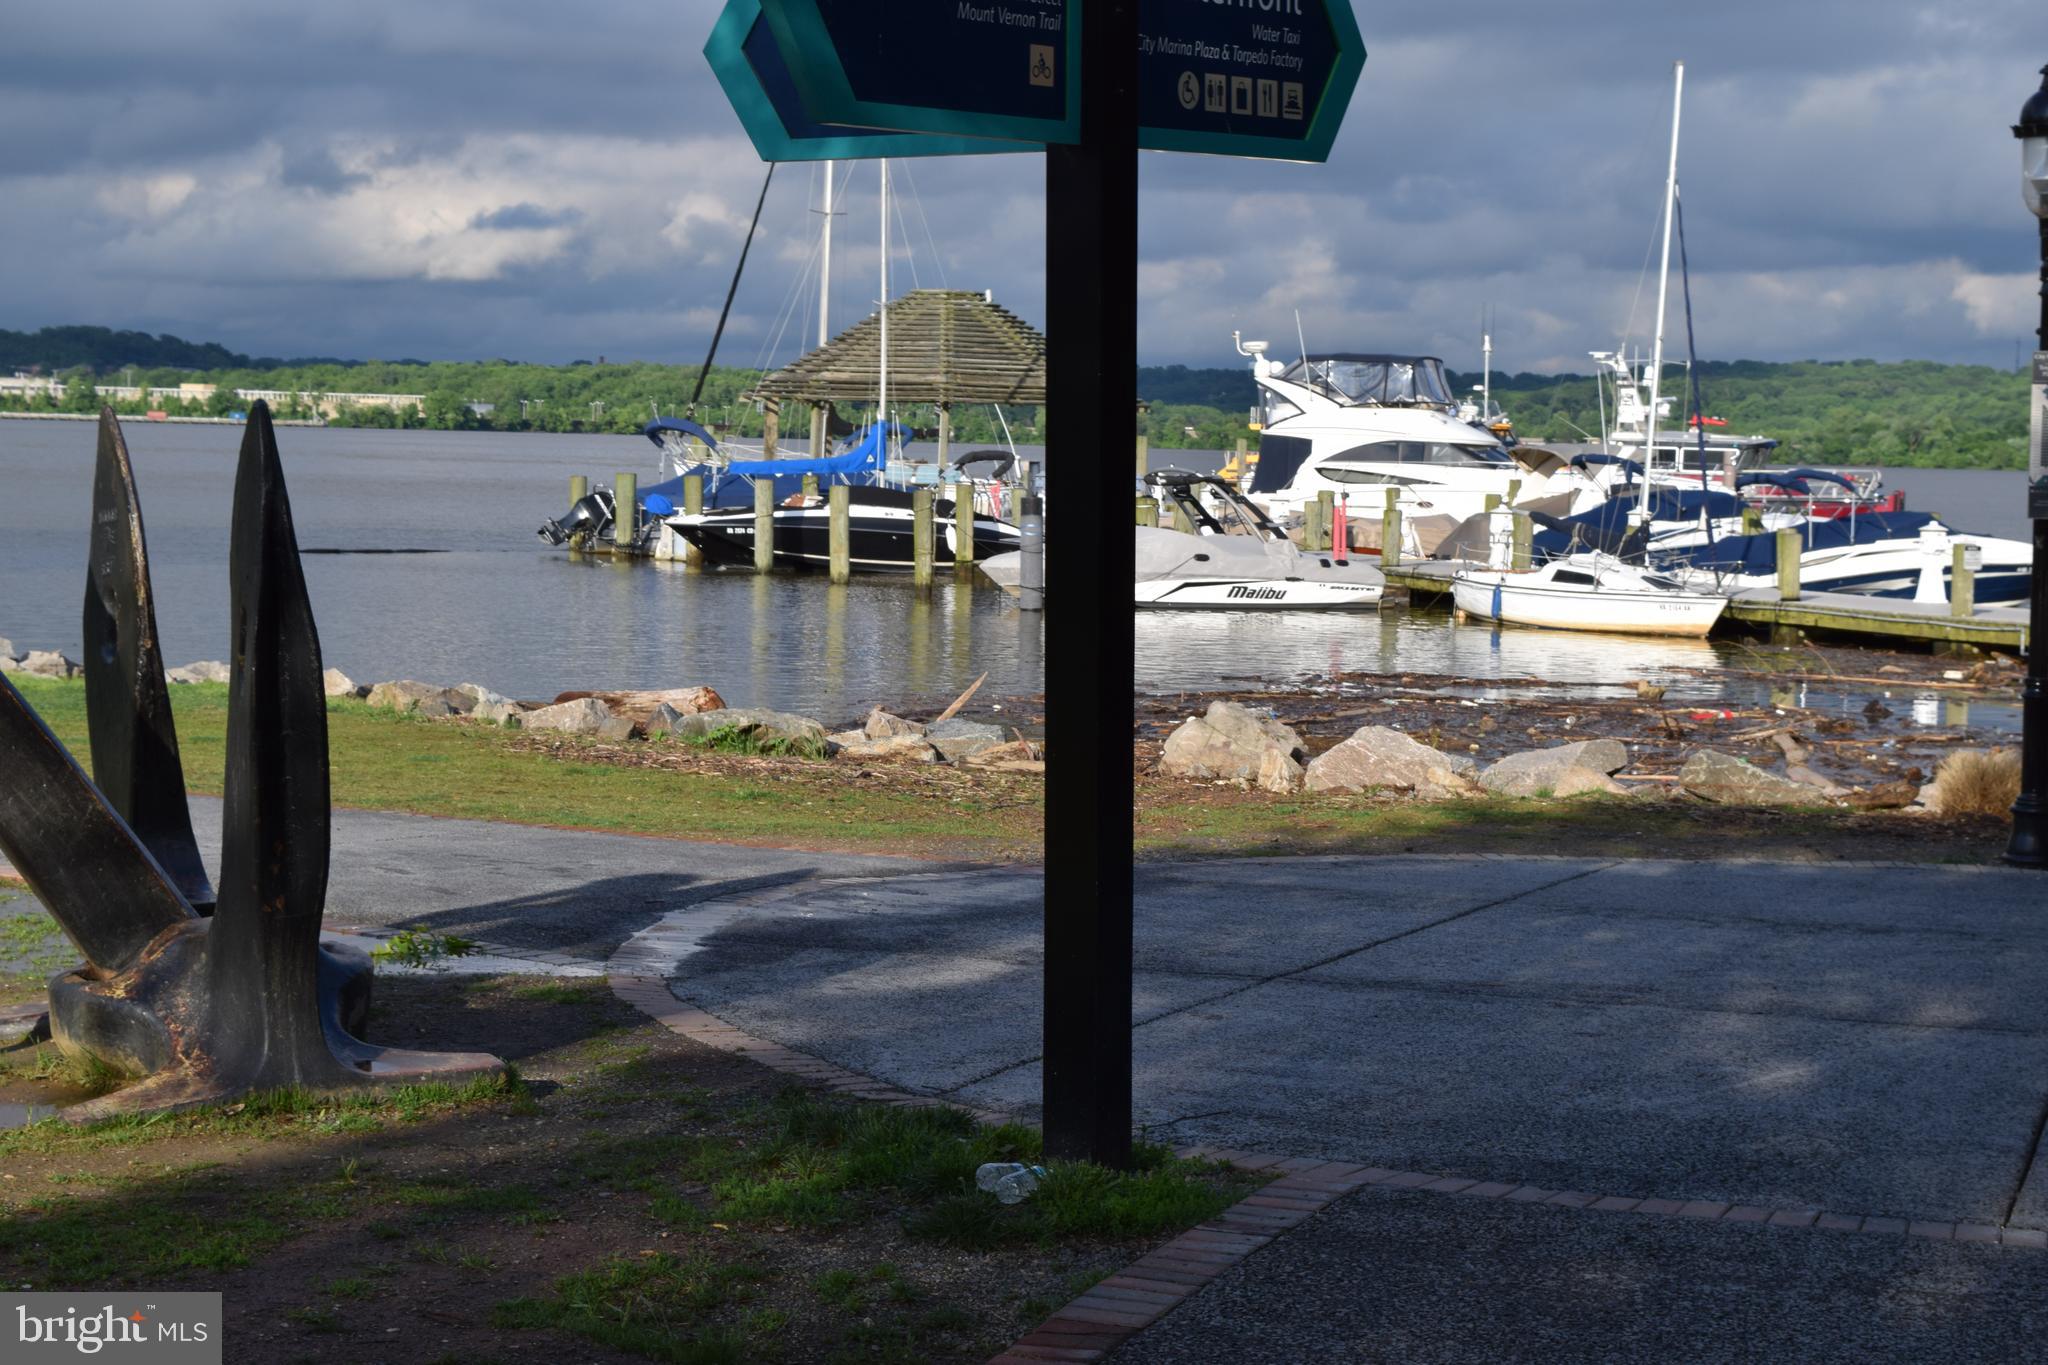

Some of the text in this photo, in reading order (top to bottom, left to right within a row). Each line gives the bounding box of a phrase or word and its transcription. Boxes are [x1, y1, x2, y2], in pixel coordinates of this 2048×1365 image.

[957, 1, 1062, 31] Mount Vernon Trail
[1252, 24, 1301, 45] Water Taxi
[1158, 36, 1193, 56] Marina
[1194, 40, 1220, 60] Plaza
[1222, 44, 1230, 60] &
[1232, 45, 1268, 66] Torpedo
[1270, 49, 1303, 72] Factory
[1227, 585, 1287, 600] Malibu
